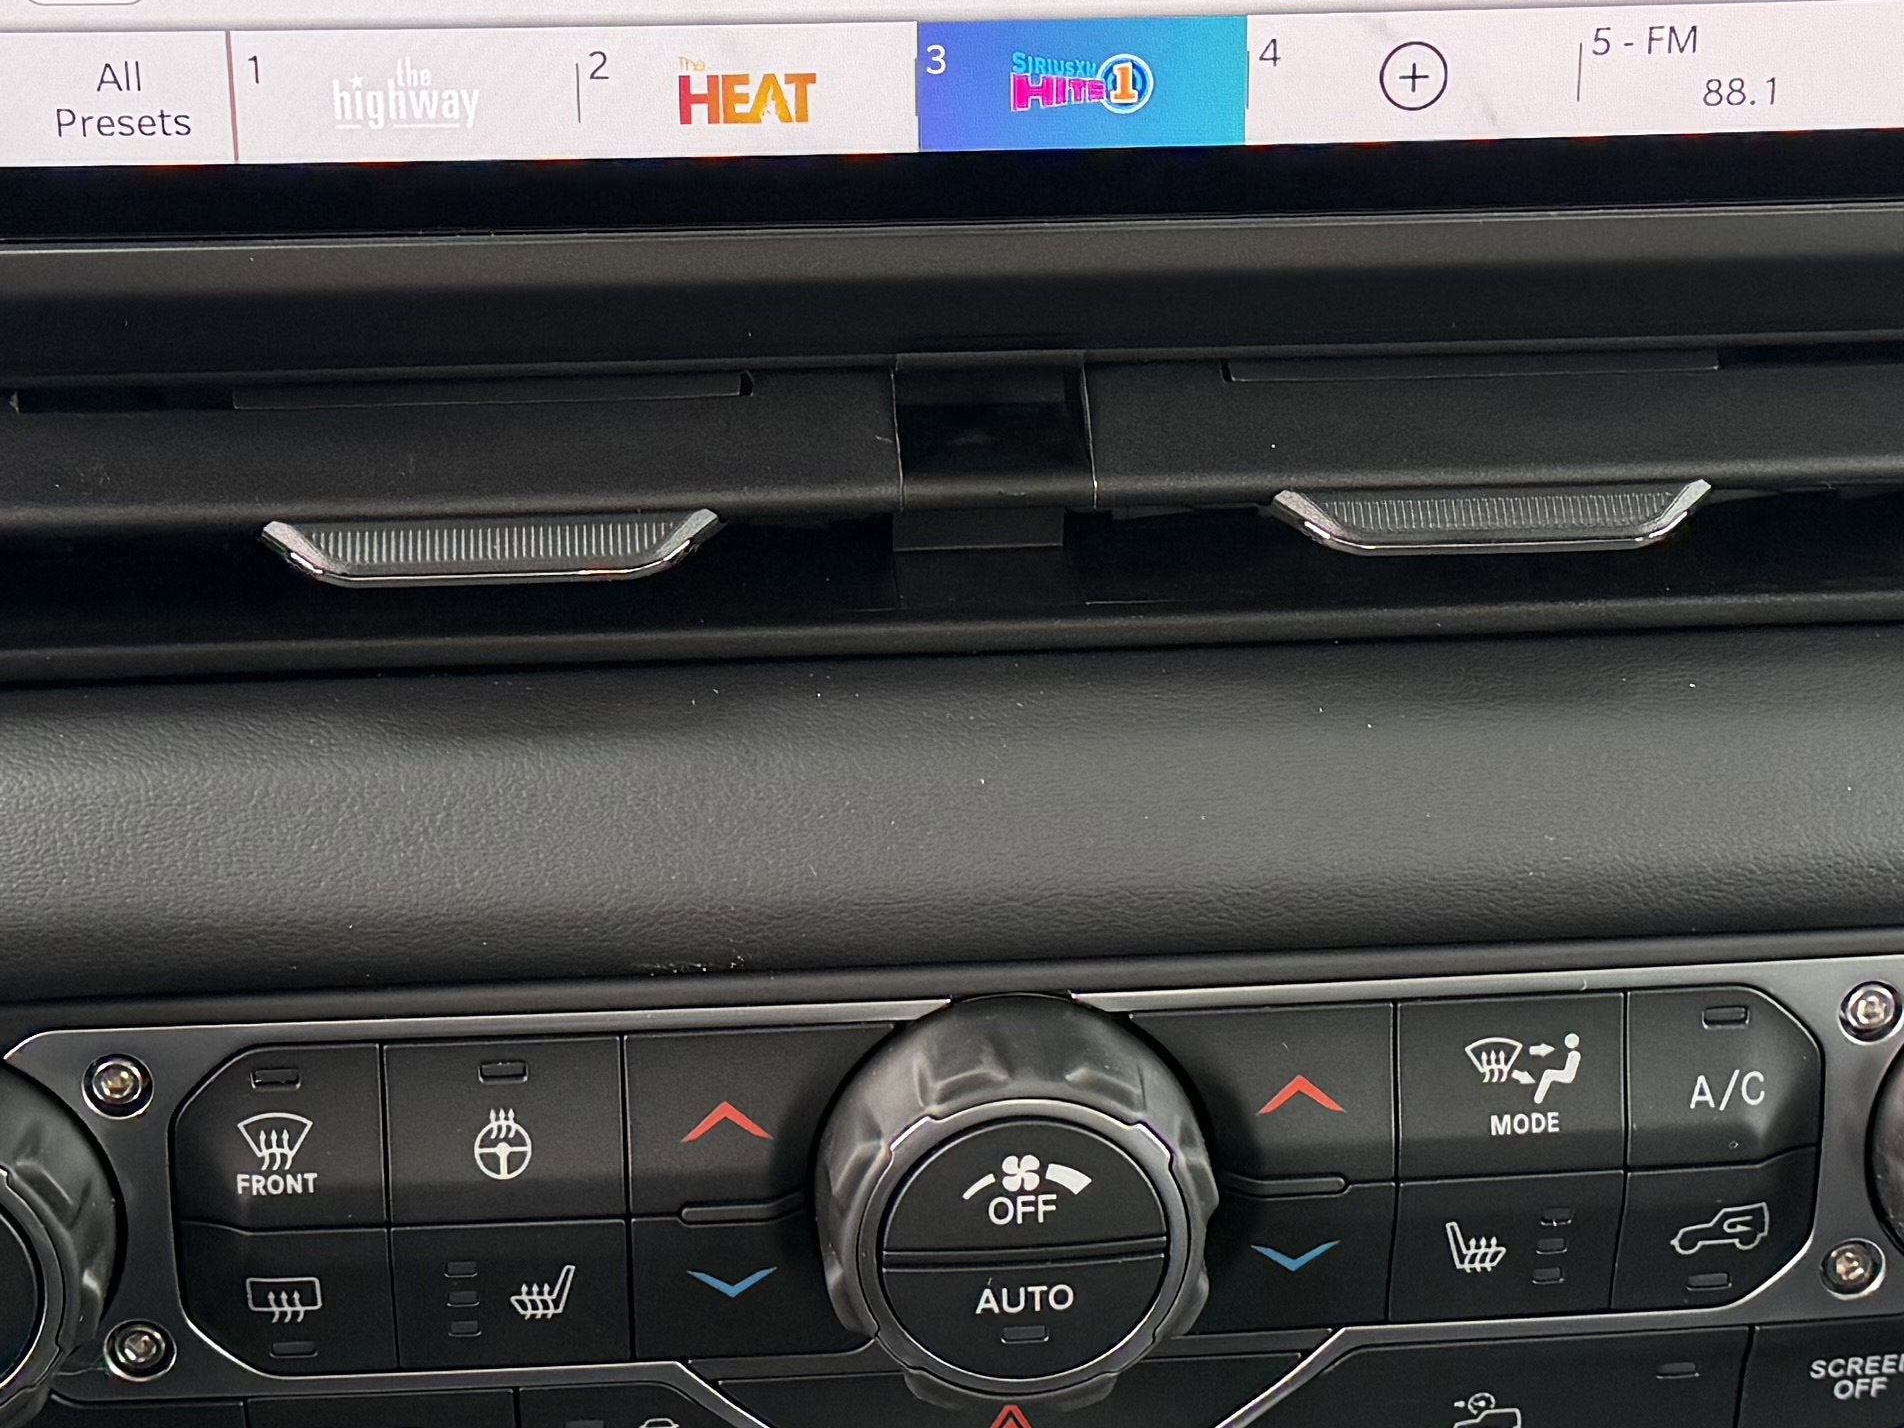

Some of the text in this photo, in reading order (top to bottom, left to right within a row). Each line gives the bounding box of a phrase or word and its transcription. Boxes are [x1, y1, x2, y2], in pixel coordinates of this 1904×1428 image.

[1259, 38, 1280, 67] 4
[1591, 27, 1612, 57] 5
[1646, 26, 1699, 55] FM
[249, 55, 262, 84] 1
[397, 57, 431, 87] the
[589, 51, 609, 80] 2
[679, 56, 705, 71] The
[926, 44, 946, 75] 3
[97, 62, 143, 93] All
[1111, 62, 1138, 103] 1
[1702, 78, 1777, 107] 88.1
[332, 78, 479, 130] highway
[678, 73, 816, 125] HEAT
[56, 108, 191, 140] Presets
[1690, 1071, 1766, 1110] A/C
[1490, 1111, 1559, 1135] MODE
[236, 1173, 317, 1195] FRONT
[988, 1194, 1057, 1224] OFF
[975, 1286, 1074, 1314] AUTO
[1832, 1376, 1887, 1399] OFF
